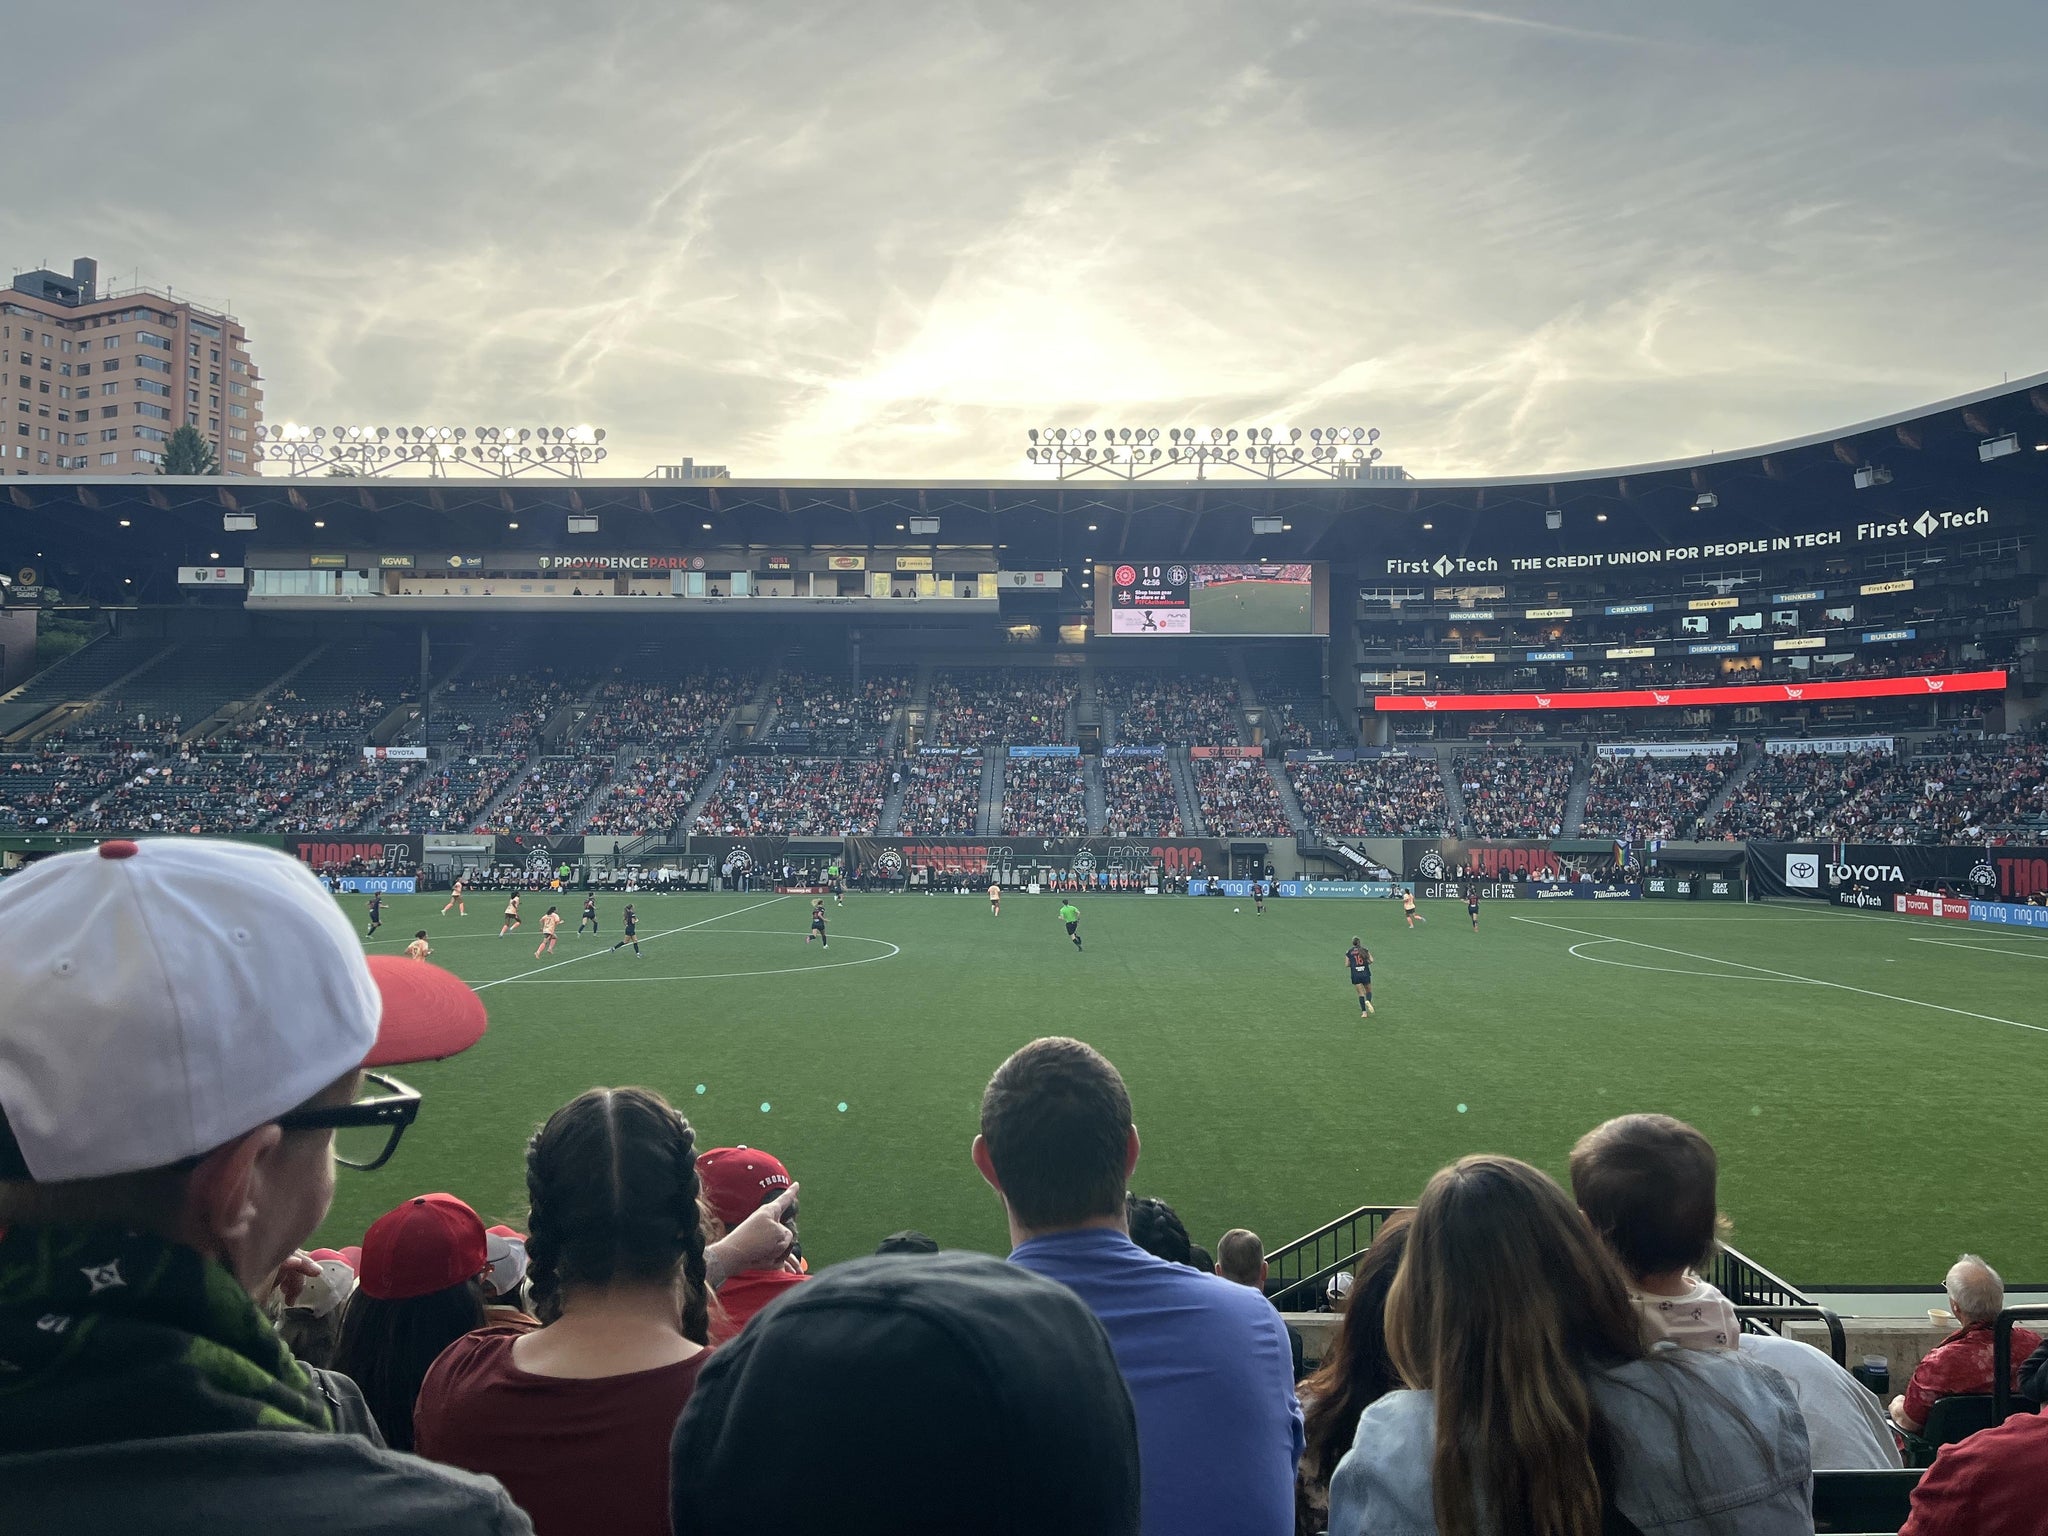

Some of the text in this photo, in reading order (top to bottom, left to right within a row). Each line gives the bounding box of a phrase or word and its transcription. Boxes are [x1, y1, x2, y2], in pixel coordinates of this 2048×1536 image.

[1857, 507, 1989, 541] First Tech
[1511, 531, 1841, 571] THE CREDIT UNION FOR PEOPLE IN TECH
[554, 557, 688, 568] PROVIDENCE PARK
[1387, 557, 1498, 574] First Tech
[1142, 566, 1160, 577] 1 0
[1780, 593, 1817, 602] THINKERS
[1870, 632, 1907, 640] BUILDERS
[1825, 864, 1904, 882] TOYOTA
[1997, 858, 2048, 897] THO
[365, 880, 387, 892] ring
[391, 880, 414, 892] ring
[1425, 883, 1445, 898] elf
[1481, 883, 1501, 898] elf
[1536, 888, 1574, 899] Tillamook
[1593, 889, 1631, 899] Tillamook
[1840, 892, 1882, 906] First Tech
[1907, 900, 1929, 911] TOYOTA
[1943, 903, 1967, 914] TOYOTA
[1970, 904, 2048, 925] ring ring ring rin
